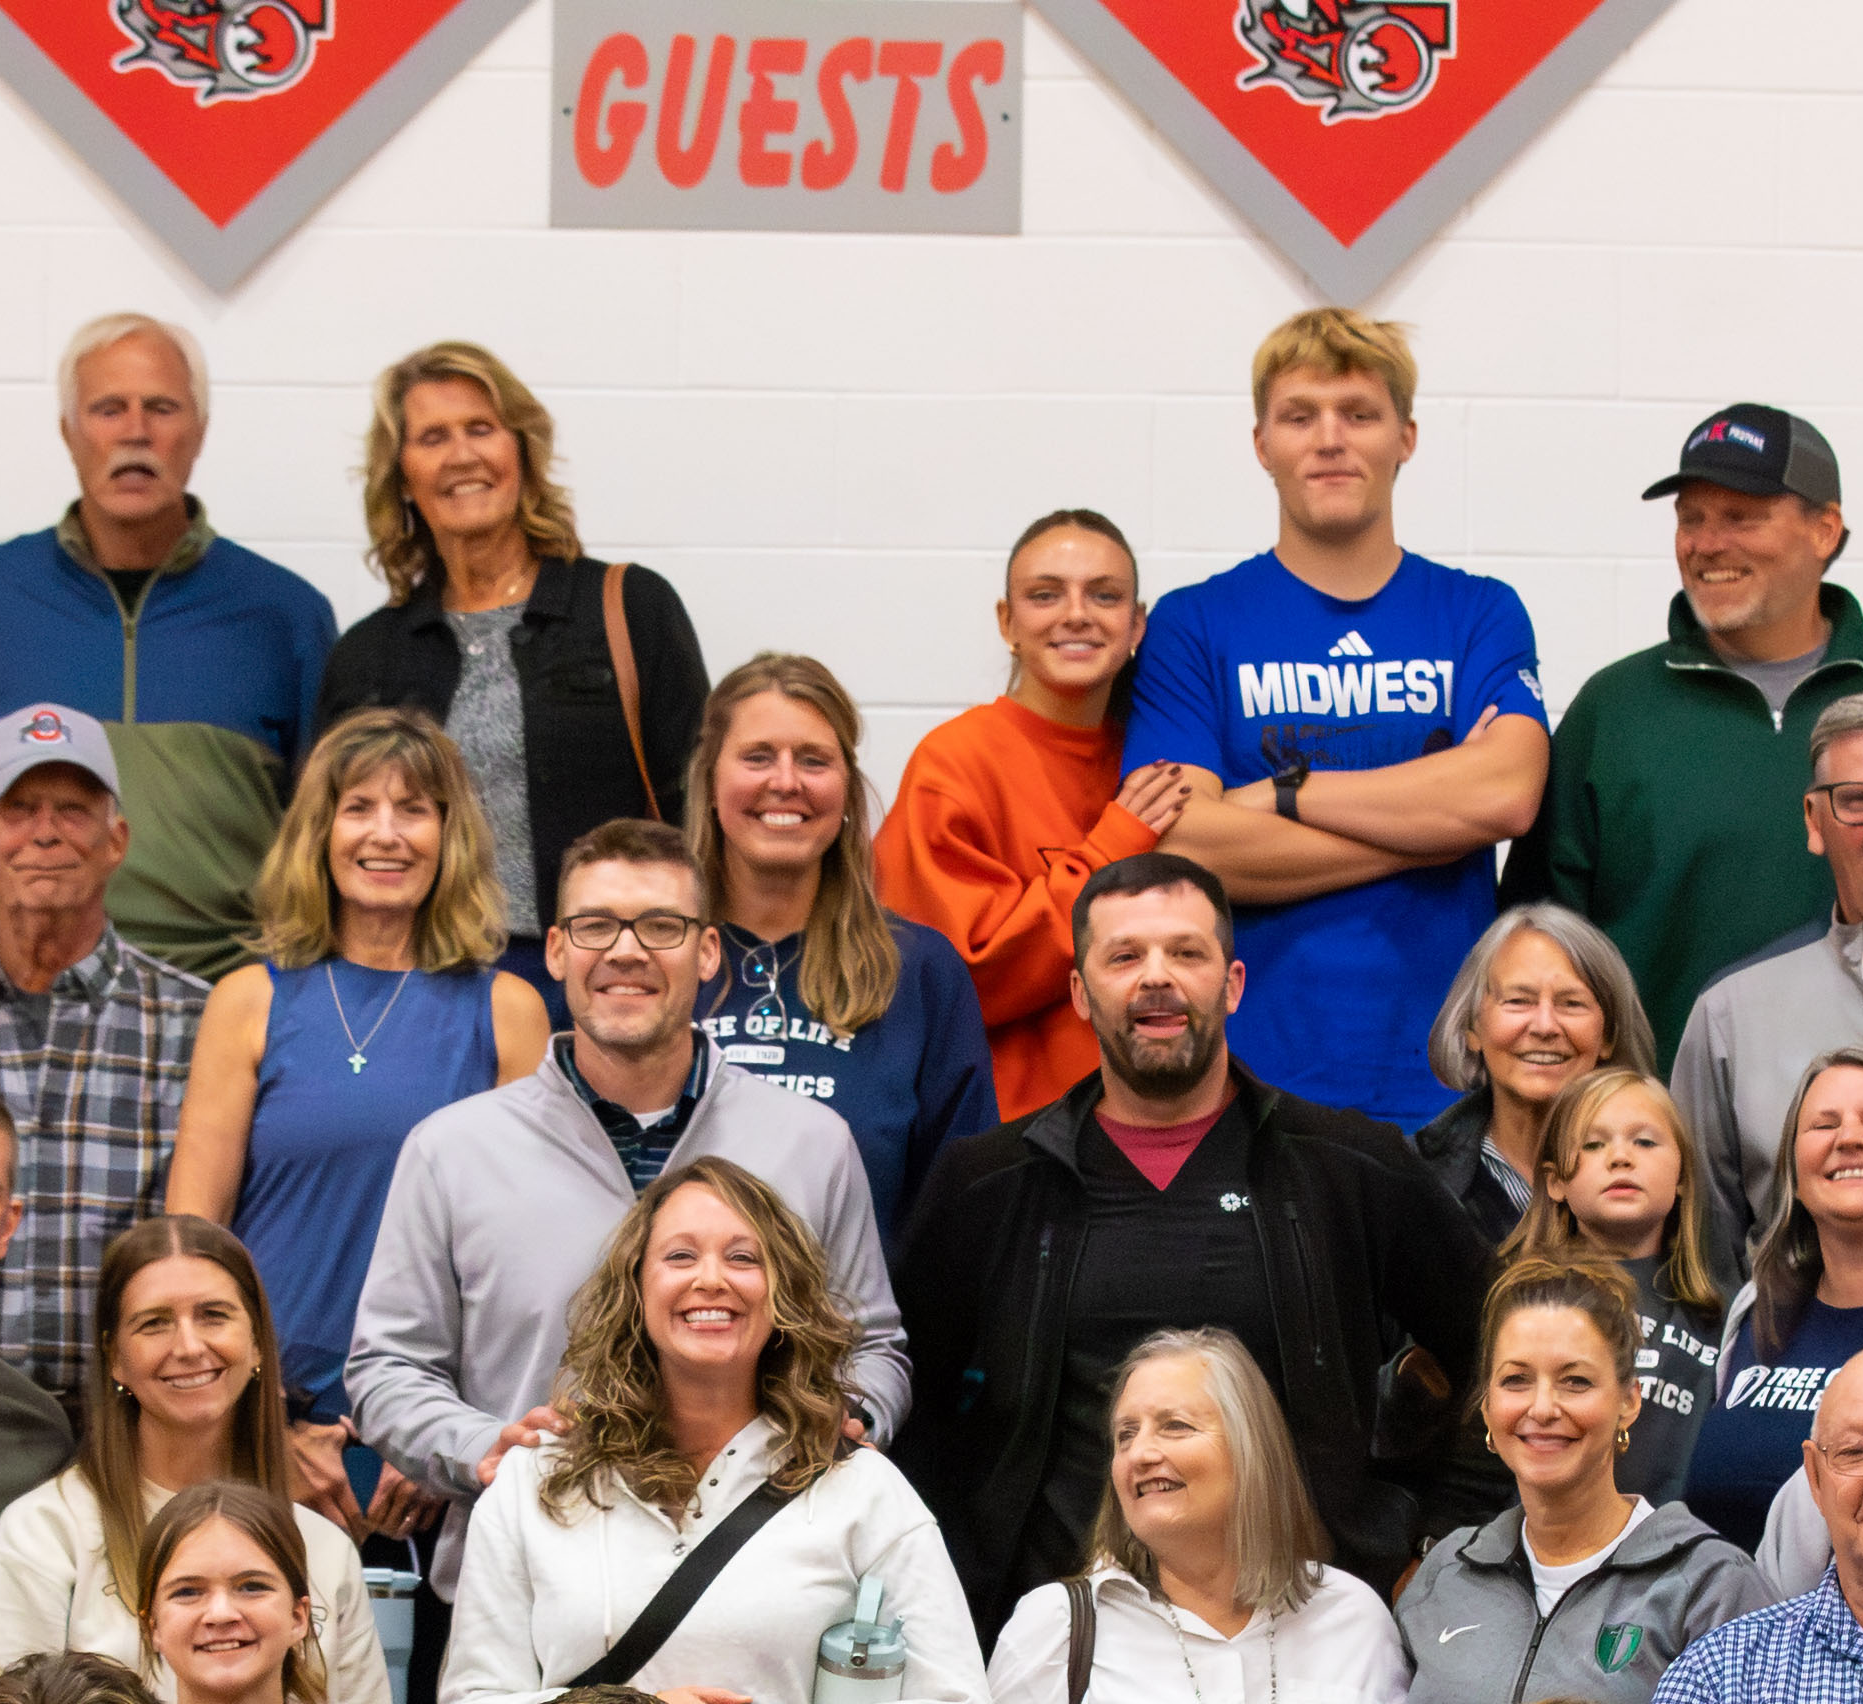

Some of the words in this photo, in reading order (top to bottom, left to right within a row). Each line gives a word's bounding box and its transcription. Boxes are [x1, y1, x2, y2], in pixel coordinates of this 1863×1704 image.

[573, 32, 1005, 193] GUESTS
[1238, 660, 1453, 718] MIDWEST
[691, 1016, 737, 1037] EE
[745, 1015, 782, 1035] OF
[1662, 1324, 1719, 1366] LIFE
[1766, 1367, 1826, 1388] TREE
[1750, 1387, 1824, 1410] ATHLE
